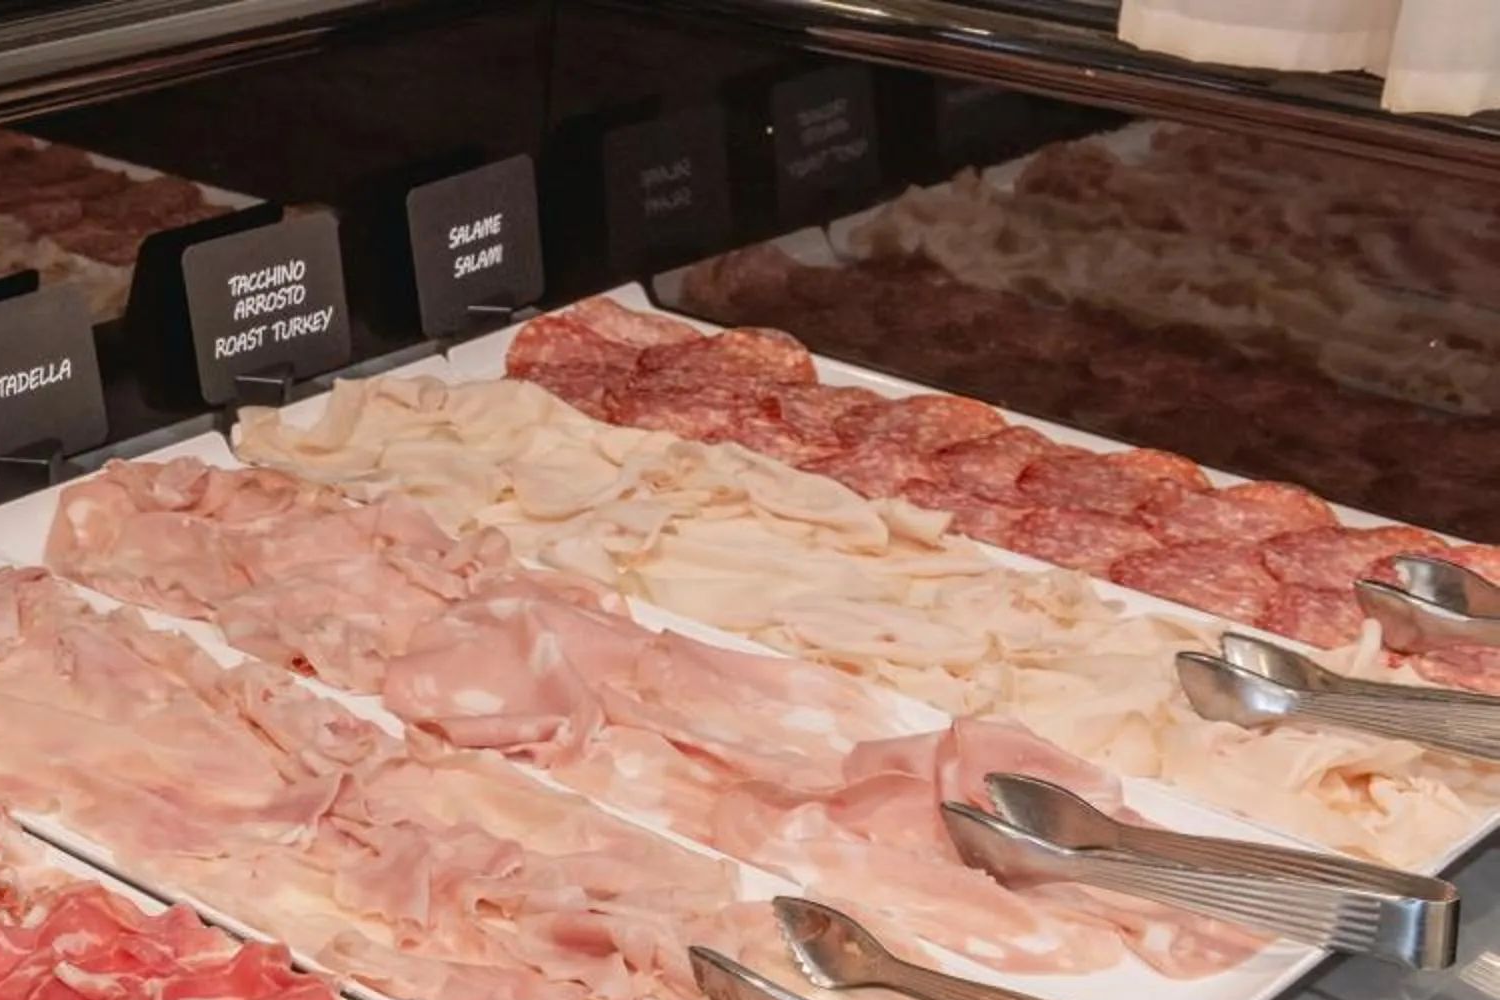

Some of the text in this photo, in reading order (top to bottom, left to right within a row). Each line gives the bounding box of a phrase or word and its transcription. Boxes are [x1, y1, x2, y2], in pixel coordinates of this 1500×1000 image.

[448, 213, 503, 249] SALAME
[227, 259, 306, 297] TACCHINO
[233, 284, 306, 321] ARROSTO
[215, 305, 334, 360] ROAST TURKEY
